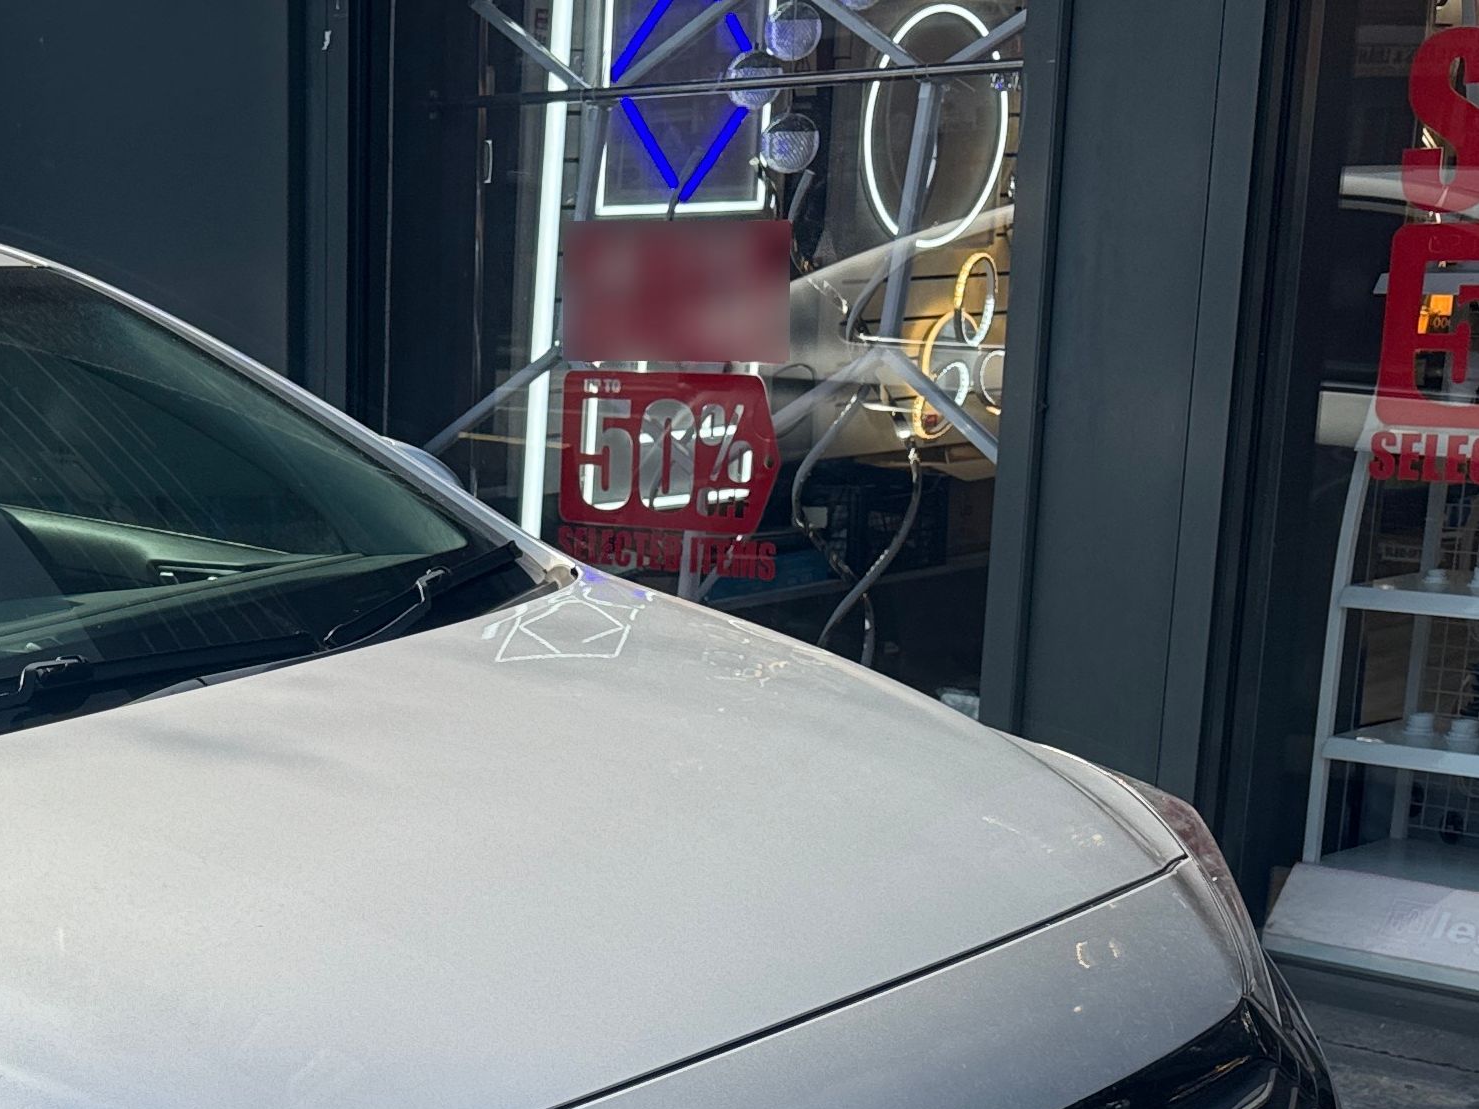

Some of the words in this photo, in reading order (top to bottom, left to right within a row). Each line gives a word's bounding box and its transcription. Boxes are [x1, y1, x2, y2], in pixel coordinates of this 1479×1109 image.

[583, 378, 599, 394] UP
[604, 379, 621, 393] TO
[579, 398, 754, 512] 50%
[696, 486, 751, 518] OFF
[558, 526, 680, 572] SELECTED
[689, 536, 777, 581] ITEMS
